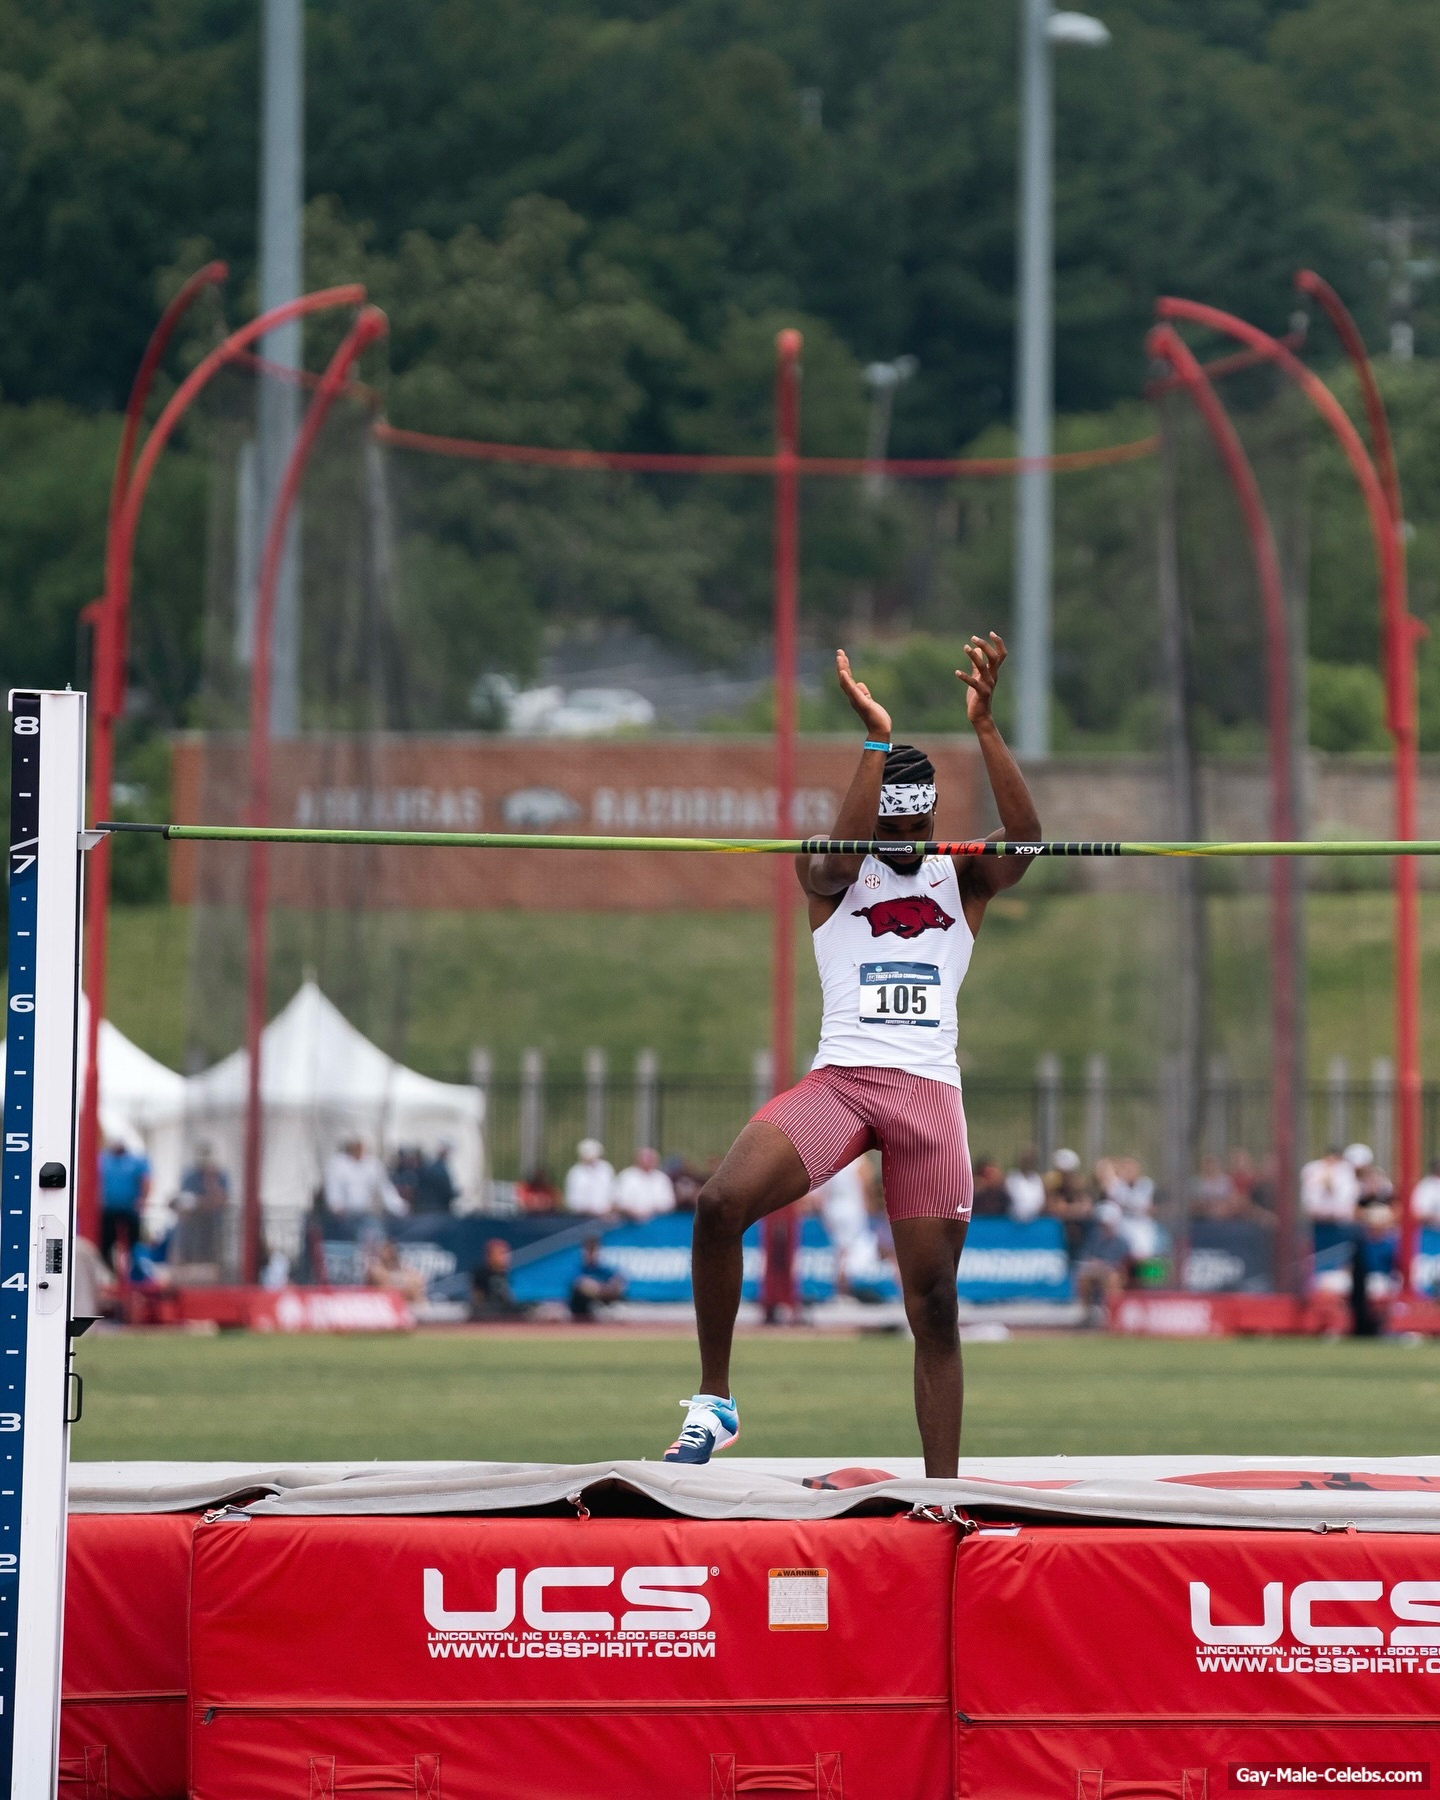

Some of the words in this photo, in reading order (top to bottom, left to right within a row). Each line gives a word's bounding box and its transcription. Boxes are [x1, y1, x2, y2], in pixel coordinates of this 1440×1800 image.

[13, 716, 39, 735] 8
[1014, 845, 1045, 855] AGX
[12, 854, 37, 874] 7
[866, 874, 880, 889] SEC
[9, 994, 35, 1013] 6
[876, 985, 927, 1015] 105
[5, 1132, 30, 1152] 5
[1, 1272, 28, 1292] 4
[0, 1412, 22, 1432] 3
[0, 1553, 18, 1573] 2
[783, 1569, 820, 1577] WARNING
[427, 1631, 519, 1642] LINCOLNTON,
[522, 1631, 543, 1641] NC
[549, 1631, 591, 1641] U.S.A.
[604, 1631, 717, 1641] 1.800.526.4856
[428, 1642, 717, 1659] WWW.UCSSPIRIT.COM
[1195, 1646, 1288, 1657] LINCOLNTON,
[1291, 1646, 1311, 1656] NC
[1317, 1646, 1361, 1656] U.S.A.
[1374, 1647, 1440, 1657] 1.800.52
